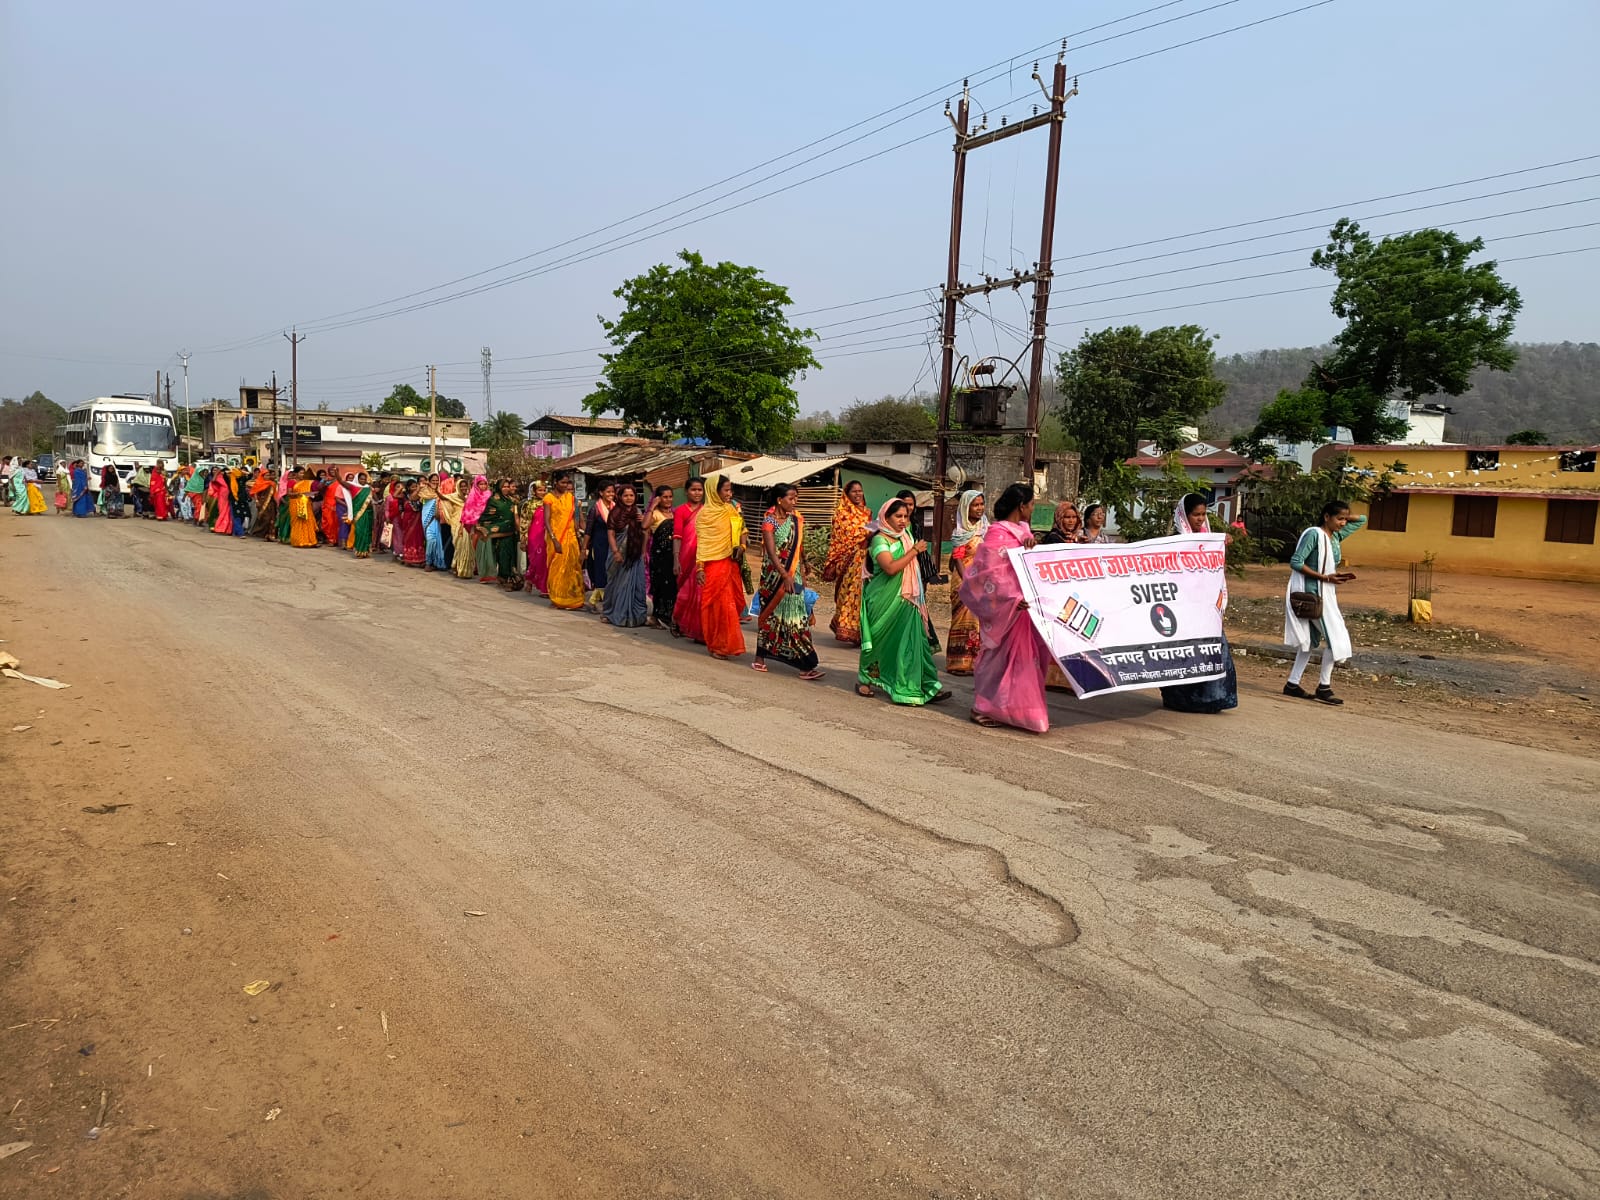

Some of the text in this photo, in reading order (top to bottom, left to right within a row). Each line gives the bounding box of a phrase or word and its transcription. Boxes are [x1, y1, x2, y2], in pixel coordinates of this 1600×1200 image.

[95, 413, 170, 427] MAHENDRA
[1035, 557, 1103, 582] मतदाता
[1131, 582, 1178, 604] SVEEP
[1101, 650, 1145, 666] जनपद
[1149, 645, 1195, 661] पंचायत
